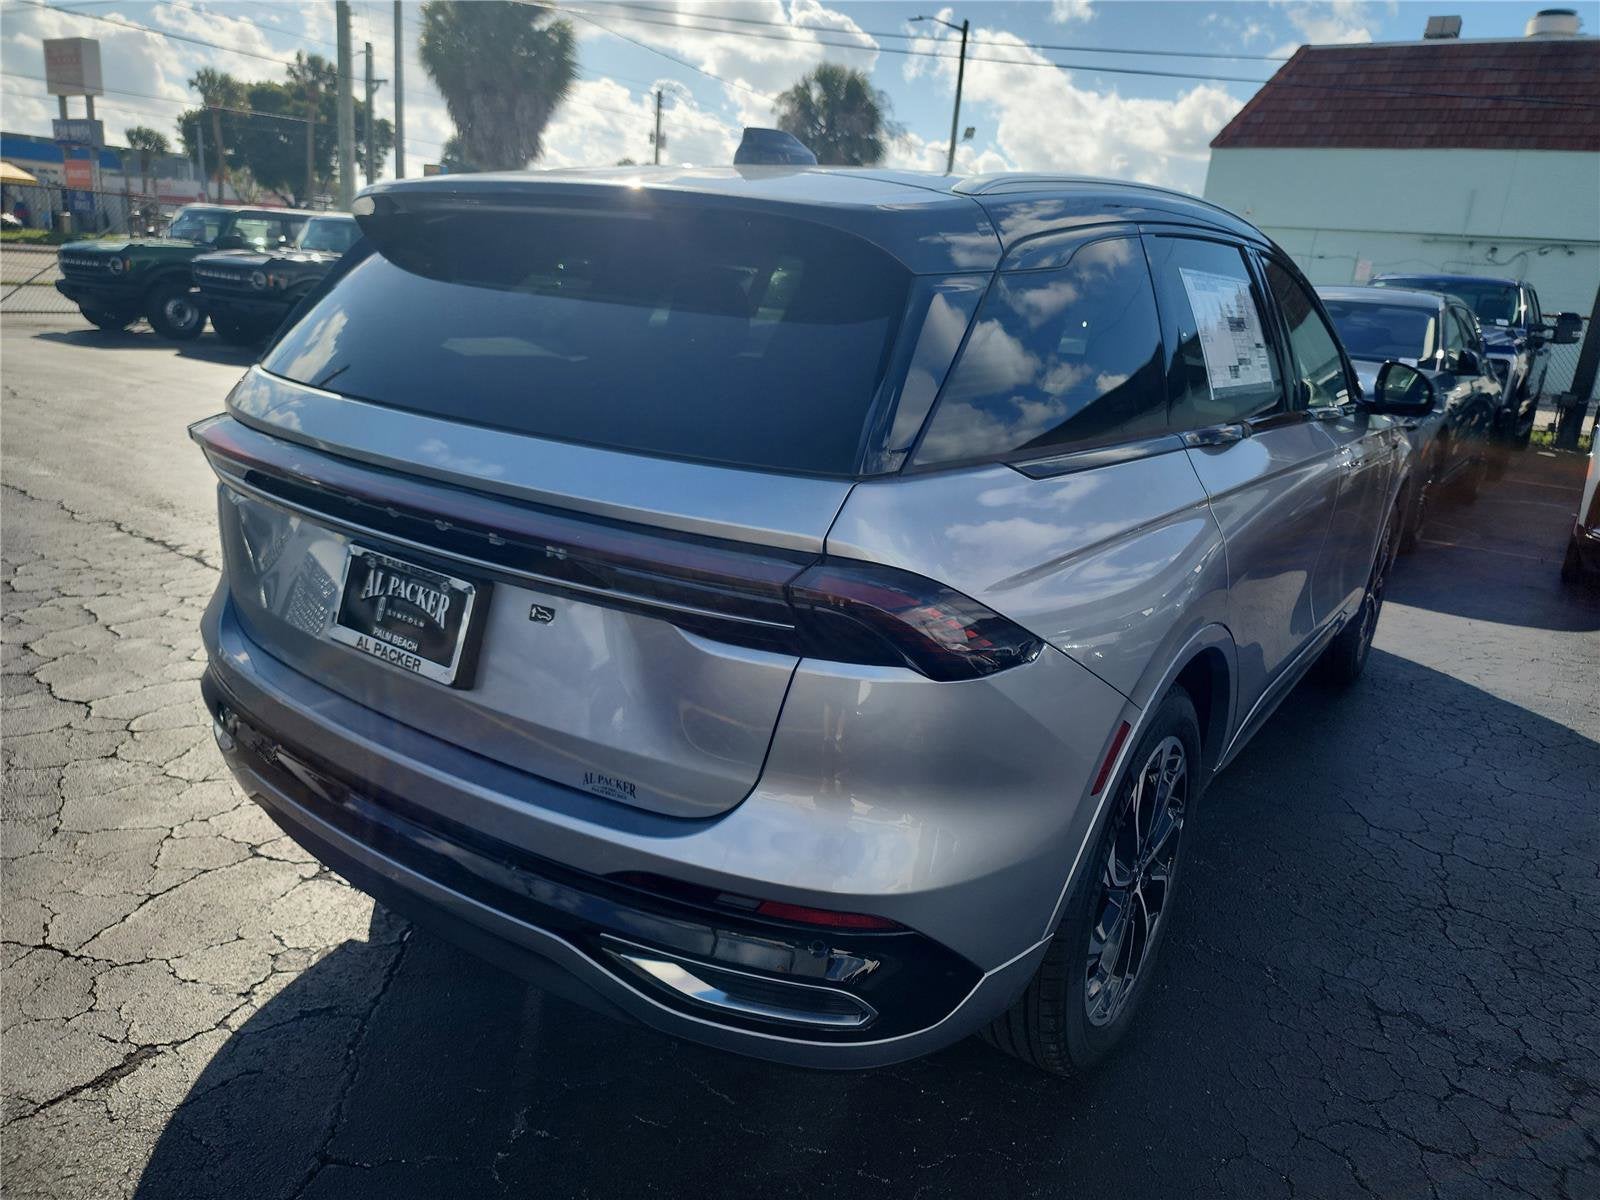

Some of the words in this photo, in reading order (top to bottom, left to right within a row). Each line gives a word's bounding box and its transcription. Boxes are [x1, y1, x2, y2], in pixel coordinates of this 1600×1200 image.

[361, 569, 385, 599] AL
[387, 576, 450, 630] PACKER
[356, 635, 370, 651] AL
[373, 642, 422, 672] PACKER
[373, 626, 393, 641] PALM
[392, 634, 418, 652] BEACH
